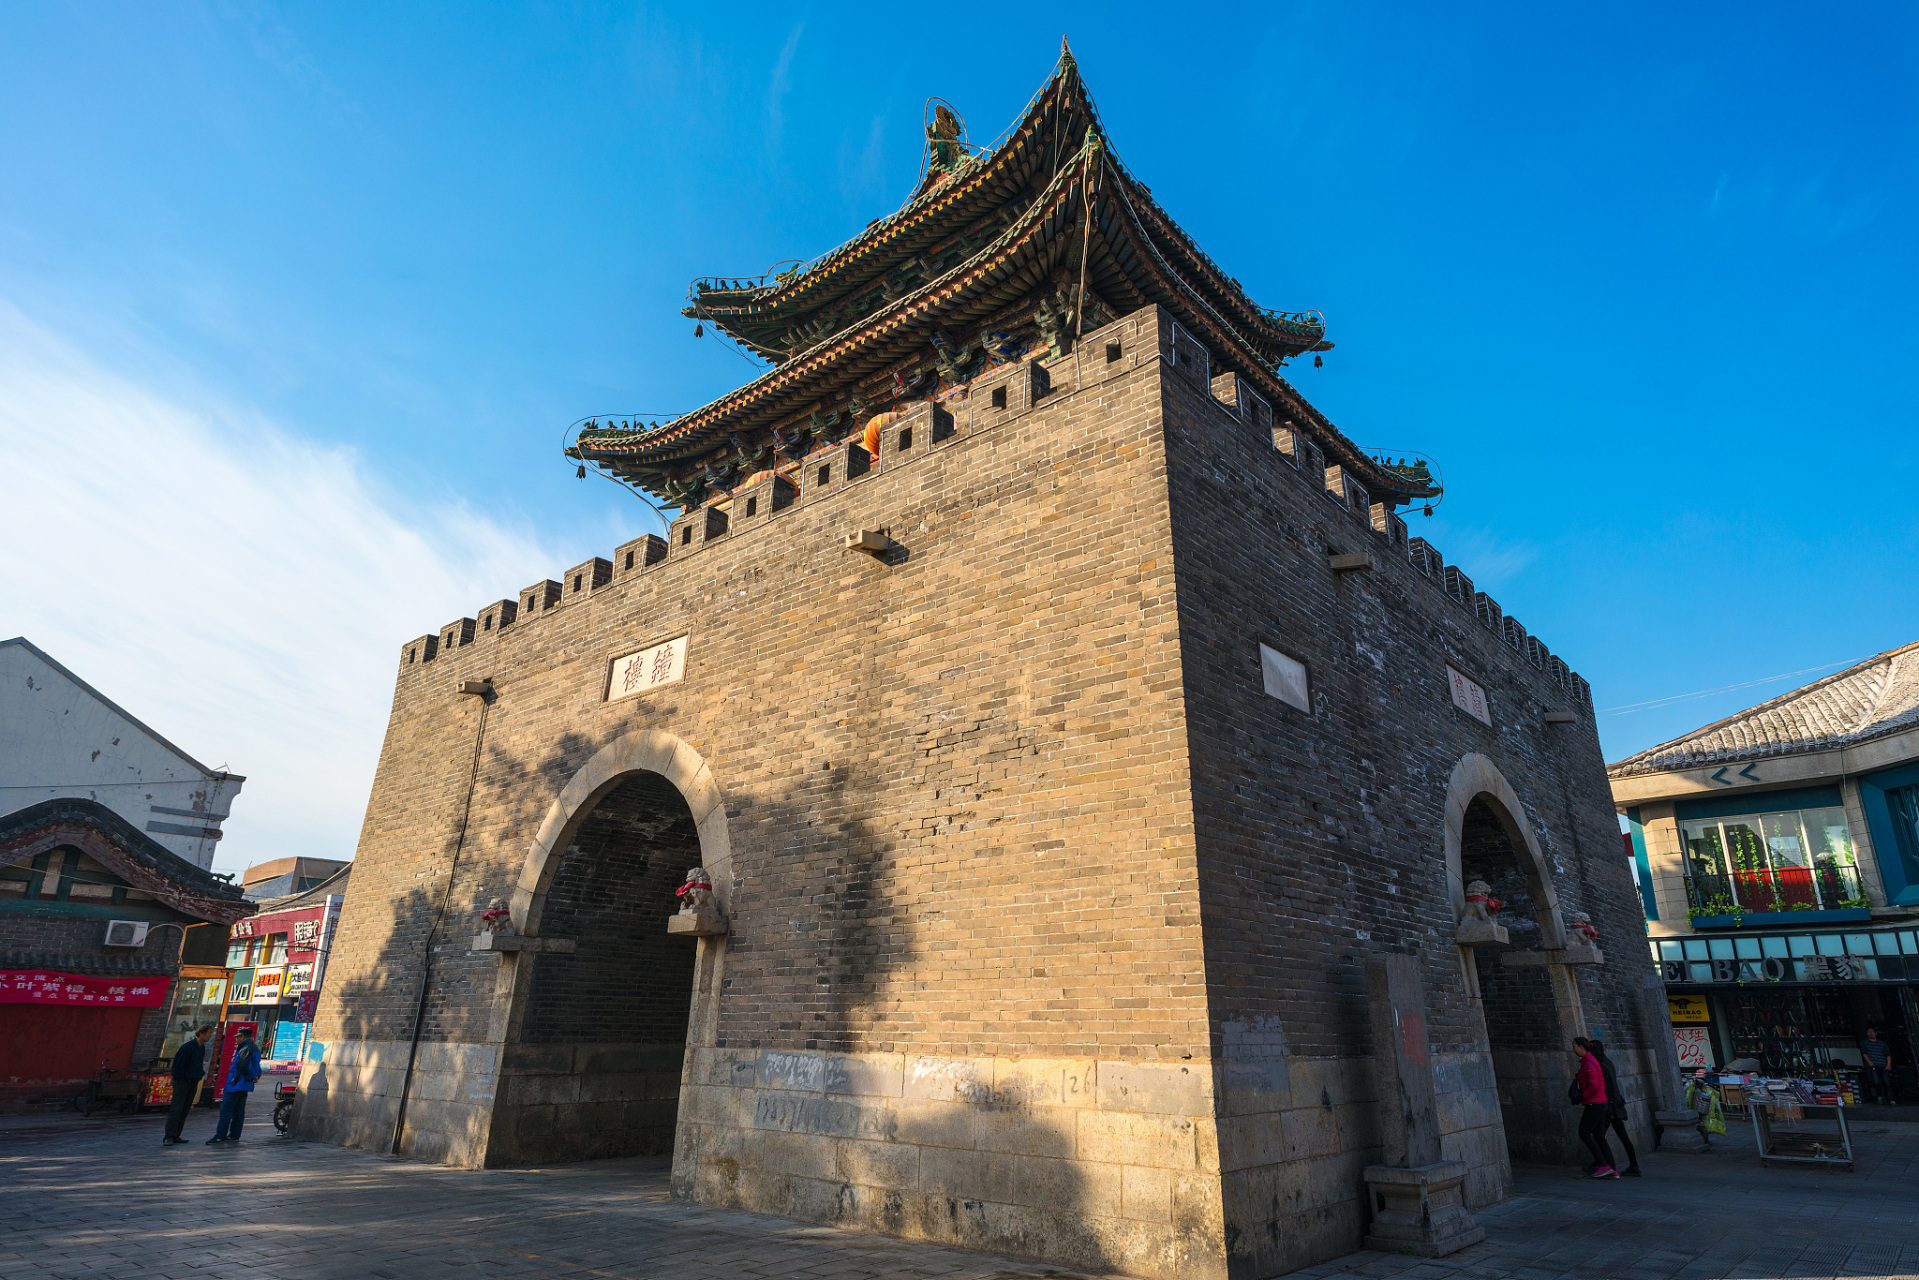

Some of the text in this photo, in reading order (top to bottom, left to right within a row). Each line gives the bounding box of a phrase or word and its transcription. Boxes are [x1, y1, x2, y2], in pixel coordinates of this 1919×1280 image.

[1712, 957, 1785, 982] BAO
[1803, 954, 1867, 981] 黑豹
[1677, 1043, 1699, 1060] 20
